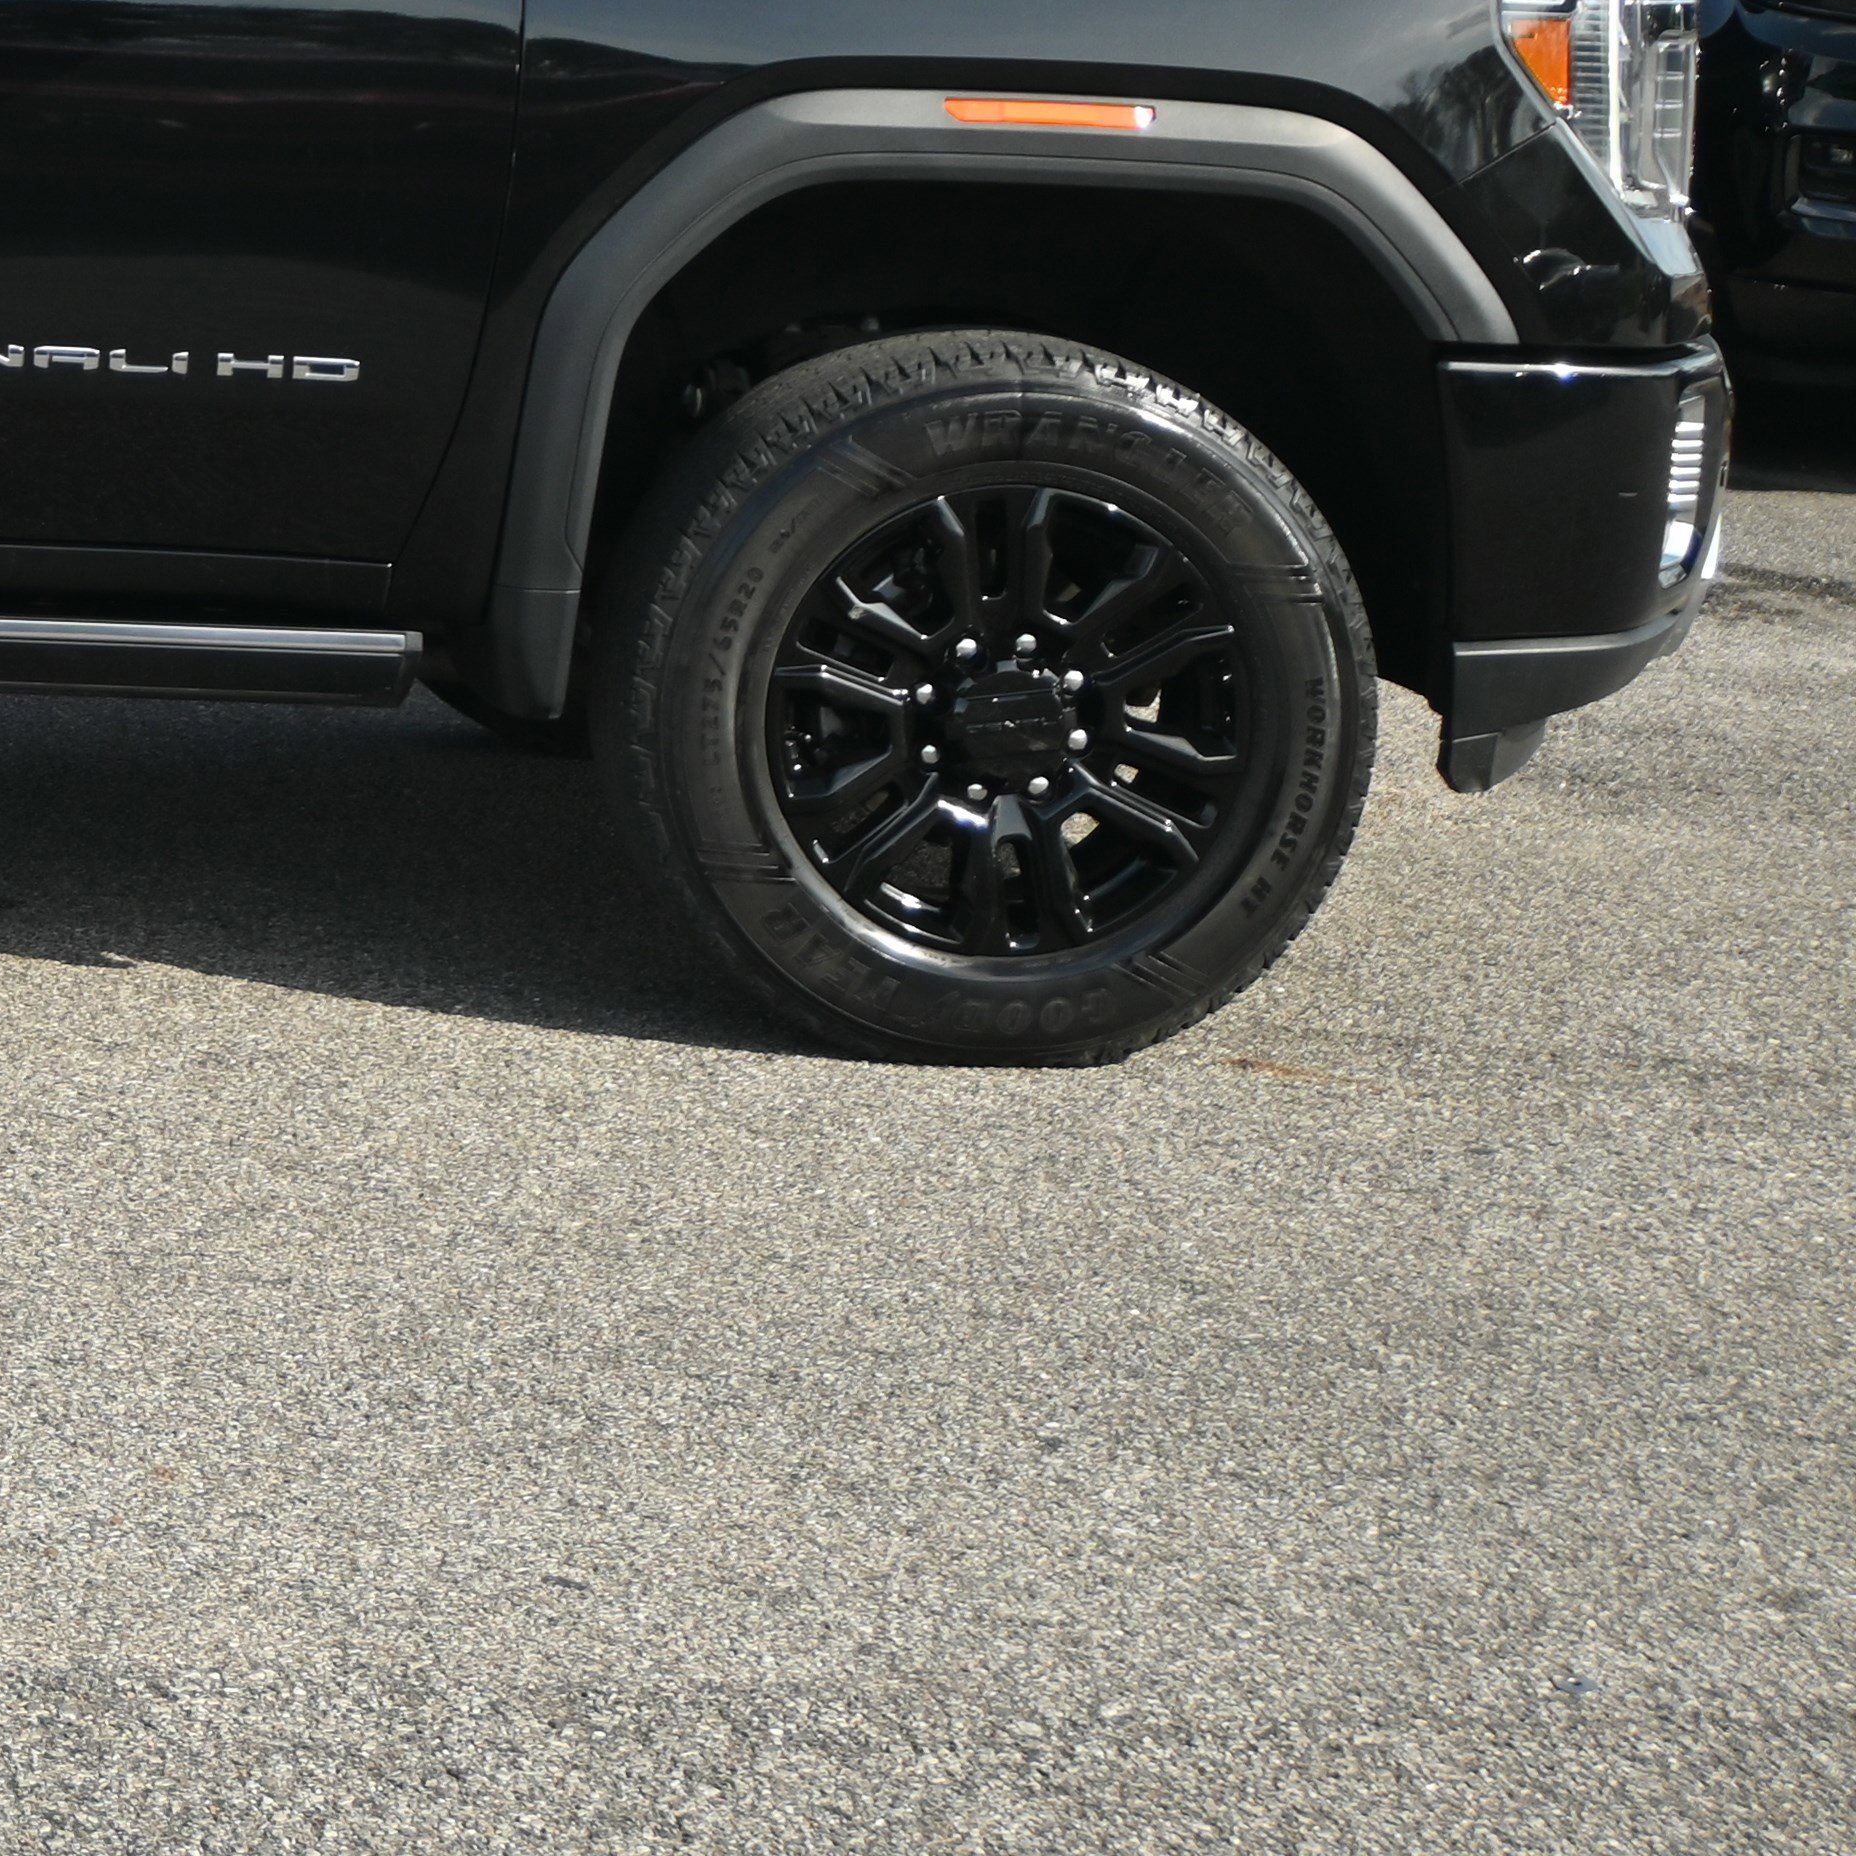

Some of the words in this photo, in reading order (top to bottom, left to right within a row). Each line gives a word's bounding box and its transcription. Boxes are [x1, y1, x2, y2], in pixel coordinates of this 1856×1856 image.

[216, 352, 361, 382] HD
[925, 409, 1254, 535] WRANGLER
[1270, 677, 1326, 873] WORKHORSE
[1240, 875, 1272, 918] HT
